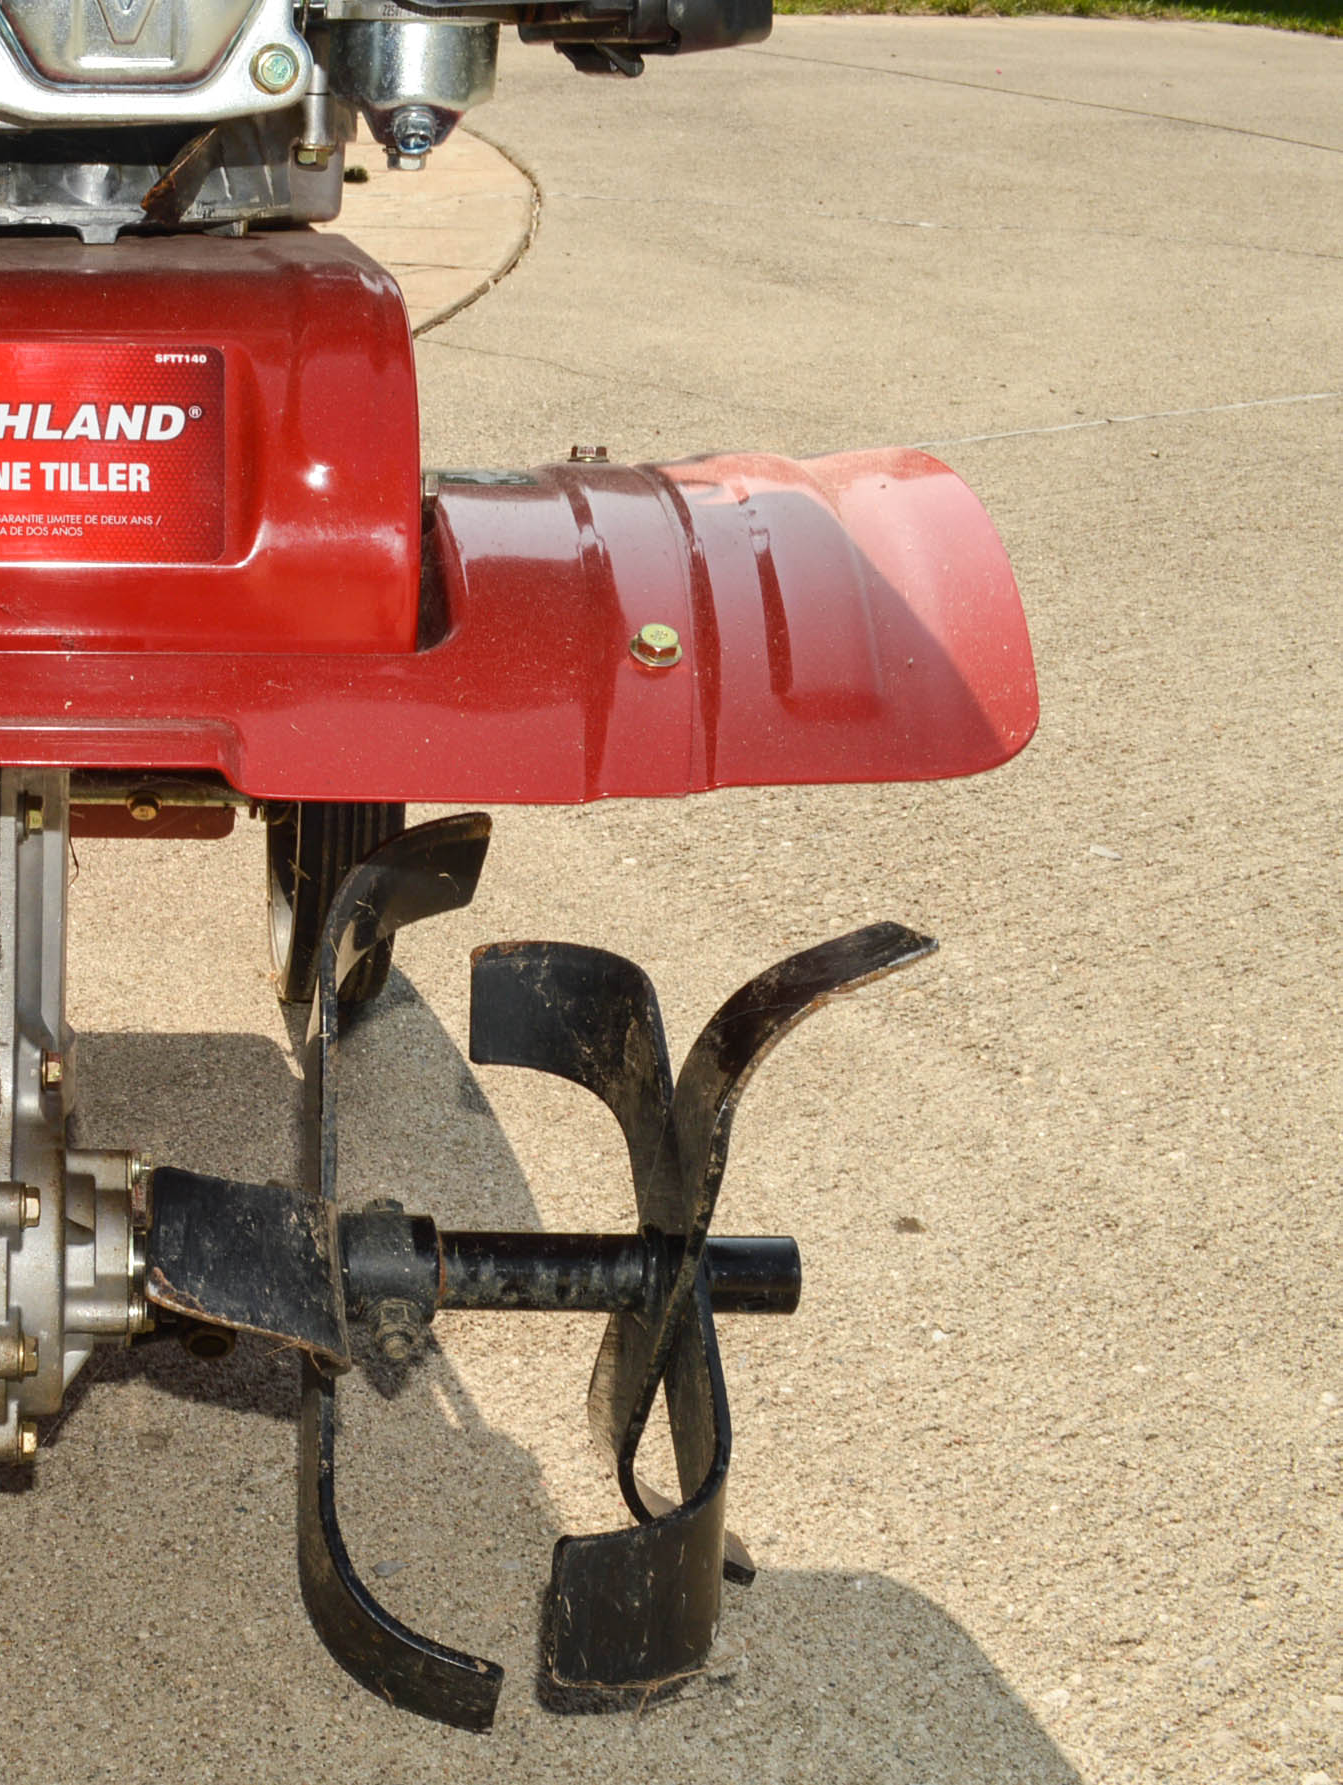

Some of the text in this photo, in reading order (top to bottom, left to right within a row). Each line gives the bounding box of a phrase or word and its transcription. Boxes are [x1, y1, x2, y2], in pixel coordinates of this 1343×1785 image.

[154, 353, 208, 364] SFTT140
[39, 462, 151, 492] TILLER
[84, 515, 98, 525] DE
[100, 515, 128, 525] DEUX
[130, 515, 154, 525] ANS
[9, 526, 24, 536] DE
[25, 526, 49, 536] DOS
[51, 524, 83, 537] AÑOS
